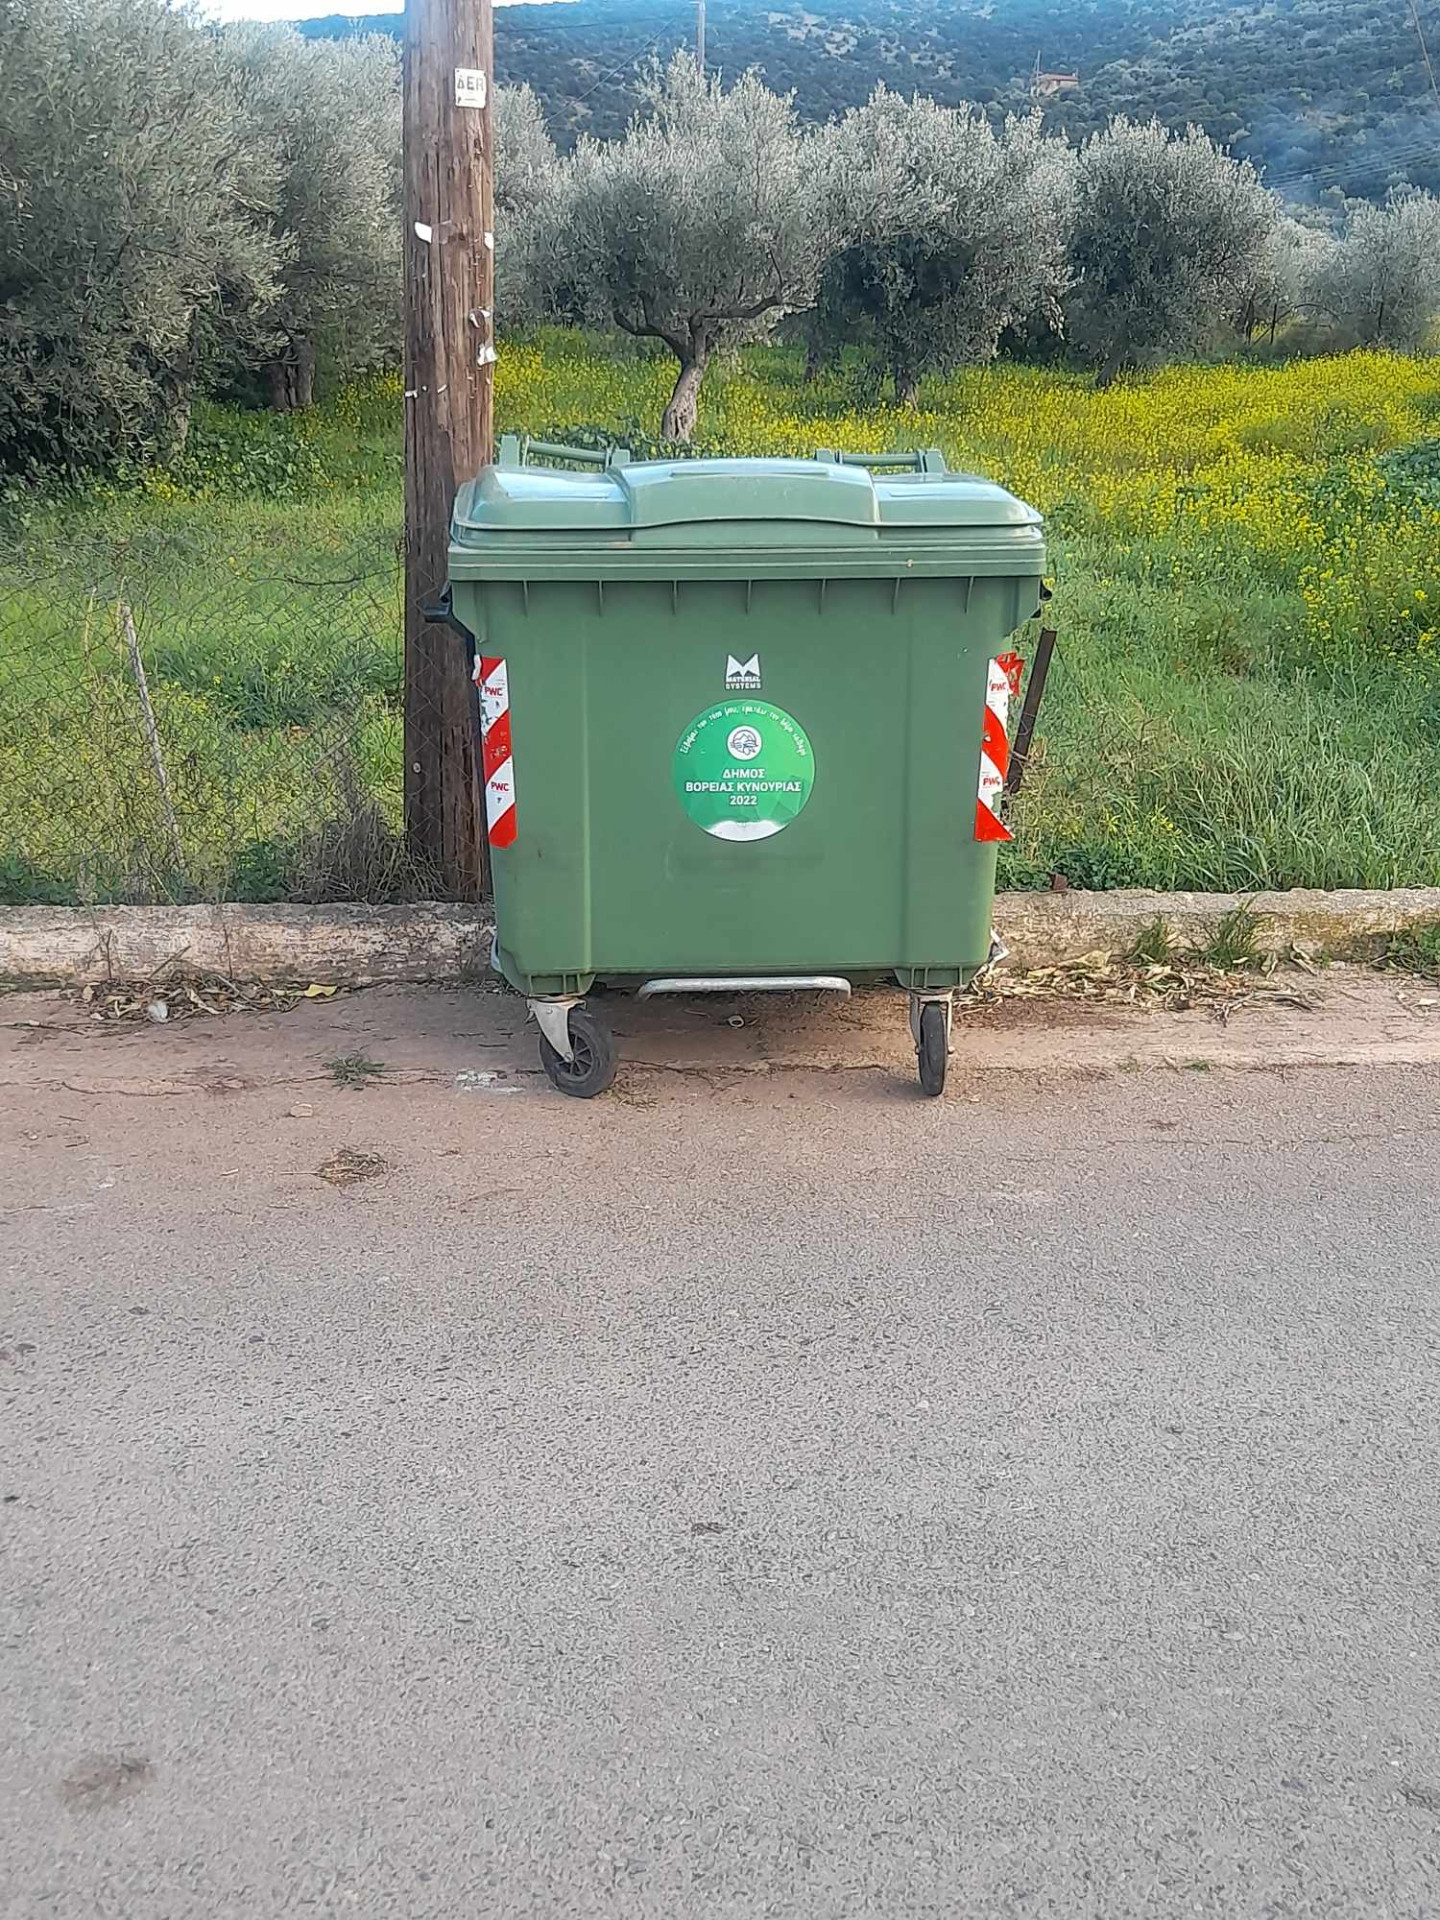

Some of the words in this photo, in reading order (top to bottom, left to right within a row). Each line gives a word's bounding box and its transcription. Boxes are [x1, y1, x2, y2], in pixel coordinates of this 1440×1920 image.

[484, 686, 503, 697] PWC
[722, 768, 766, 779] ΔΗΜΟΣ
[490, 781, 510, 792] PWC
[685, 781, 735, 792] ΒΟΡΕΙΑΣ
[736, 781, 802, 792] ΚΥΝΟΥΡΙΑΣ
[729, 795, 758, 806] 2022
